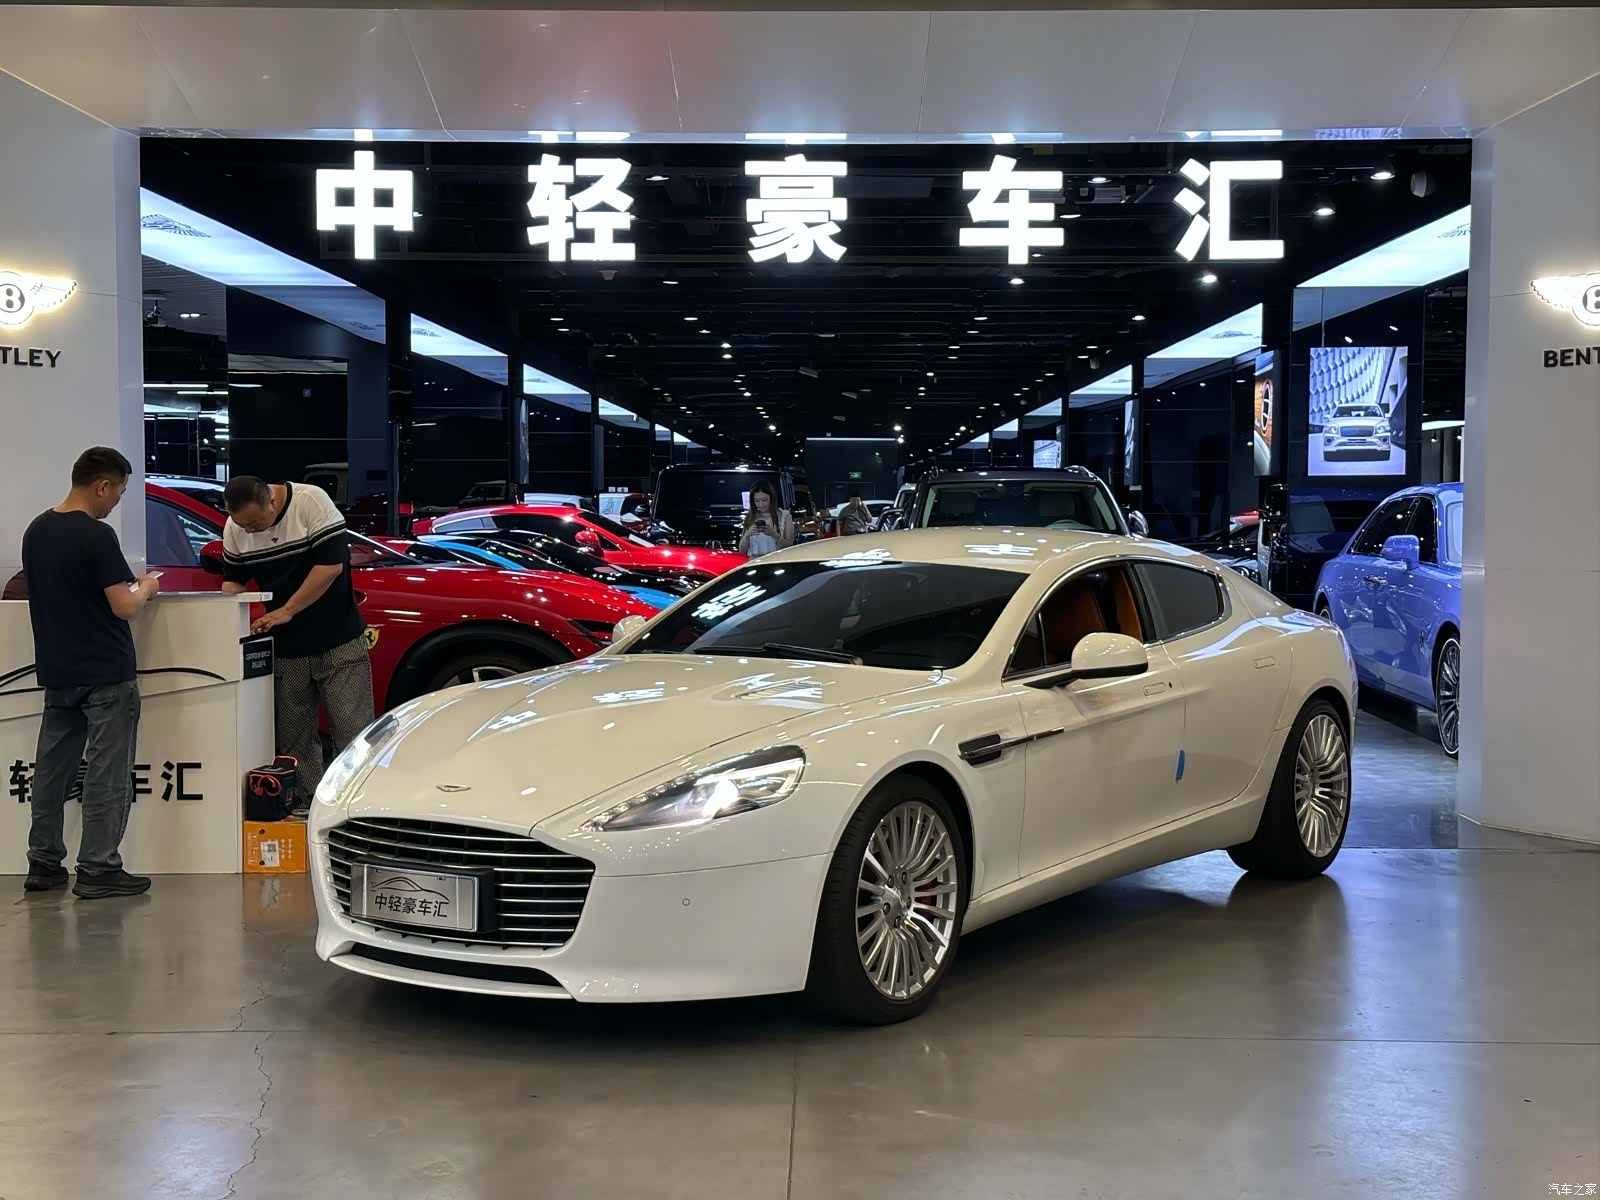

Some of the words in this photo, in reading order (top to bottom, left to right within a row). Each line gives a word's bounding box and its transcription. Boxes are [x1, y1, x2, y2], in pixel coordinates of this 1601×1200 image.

[315, 150, 1285, 265] 中轻豪车汇
[0, 345, 61, 368] TLEY
[1543, 346, 1601, 368] BENT
[374, 893, 450, 918] 中轻豪车汇
